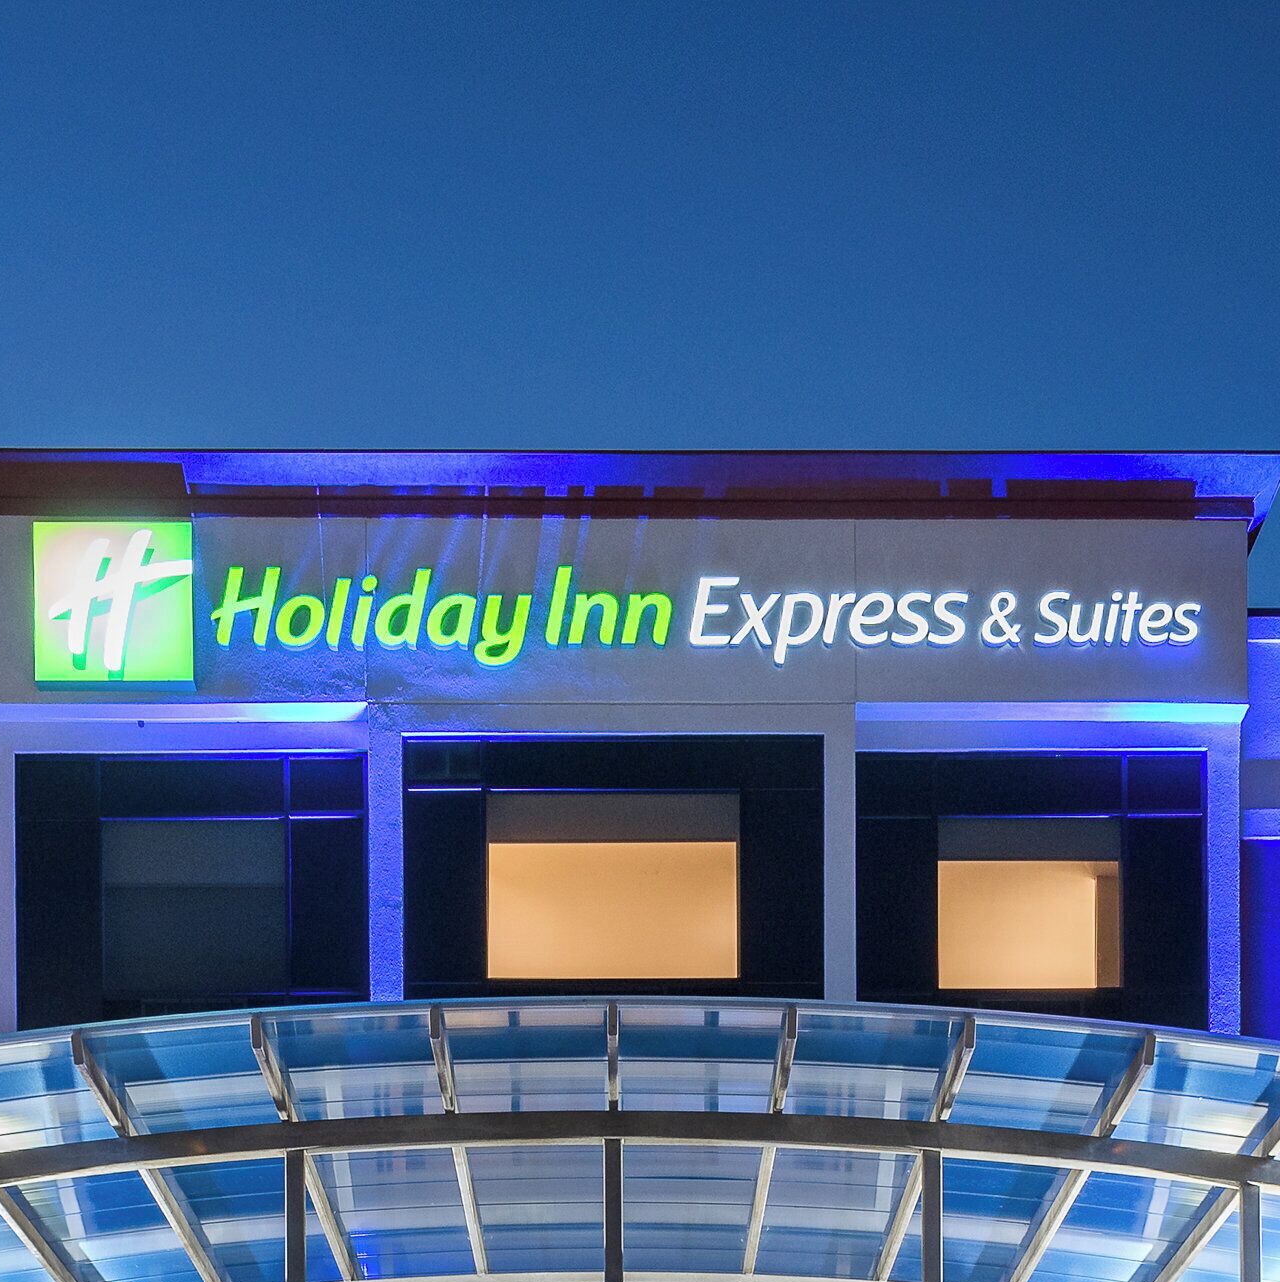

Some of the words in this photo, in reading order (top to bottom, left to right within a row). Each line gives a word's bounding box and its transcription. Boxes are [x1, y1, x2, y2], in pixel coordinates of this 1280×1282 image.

[210, 565, 532, 669] Holiday
[545, 564, 673, 649] Inn
[689, 576, 968, 668] Express
[981, 591, 1021, 648] &
[1033, 591, 1201, 647] Suites
